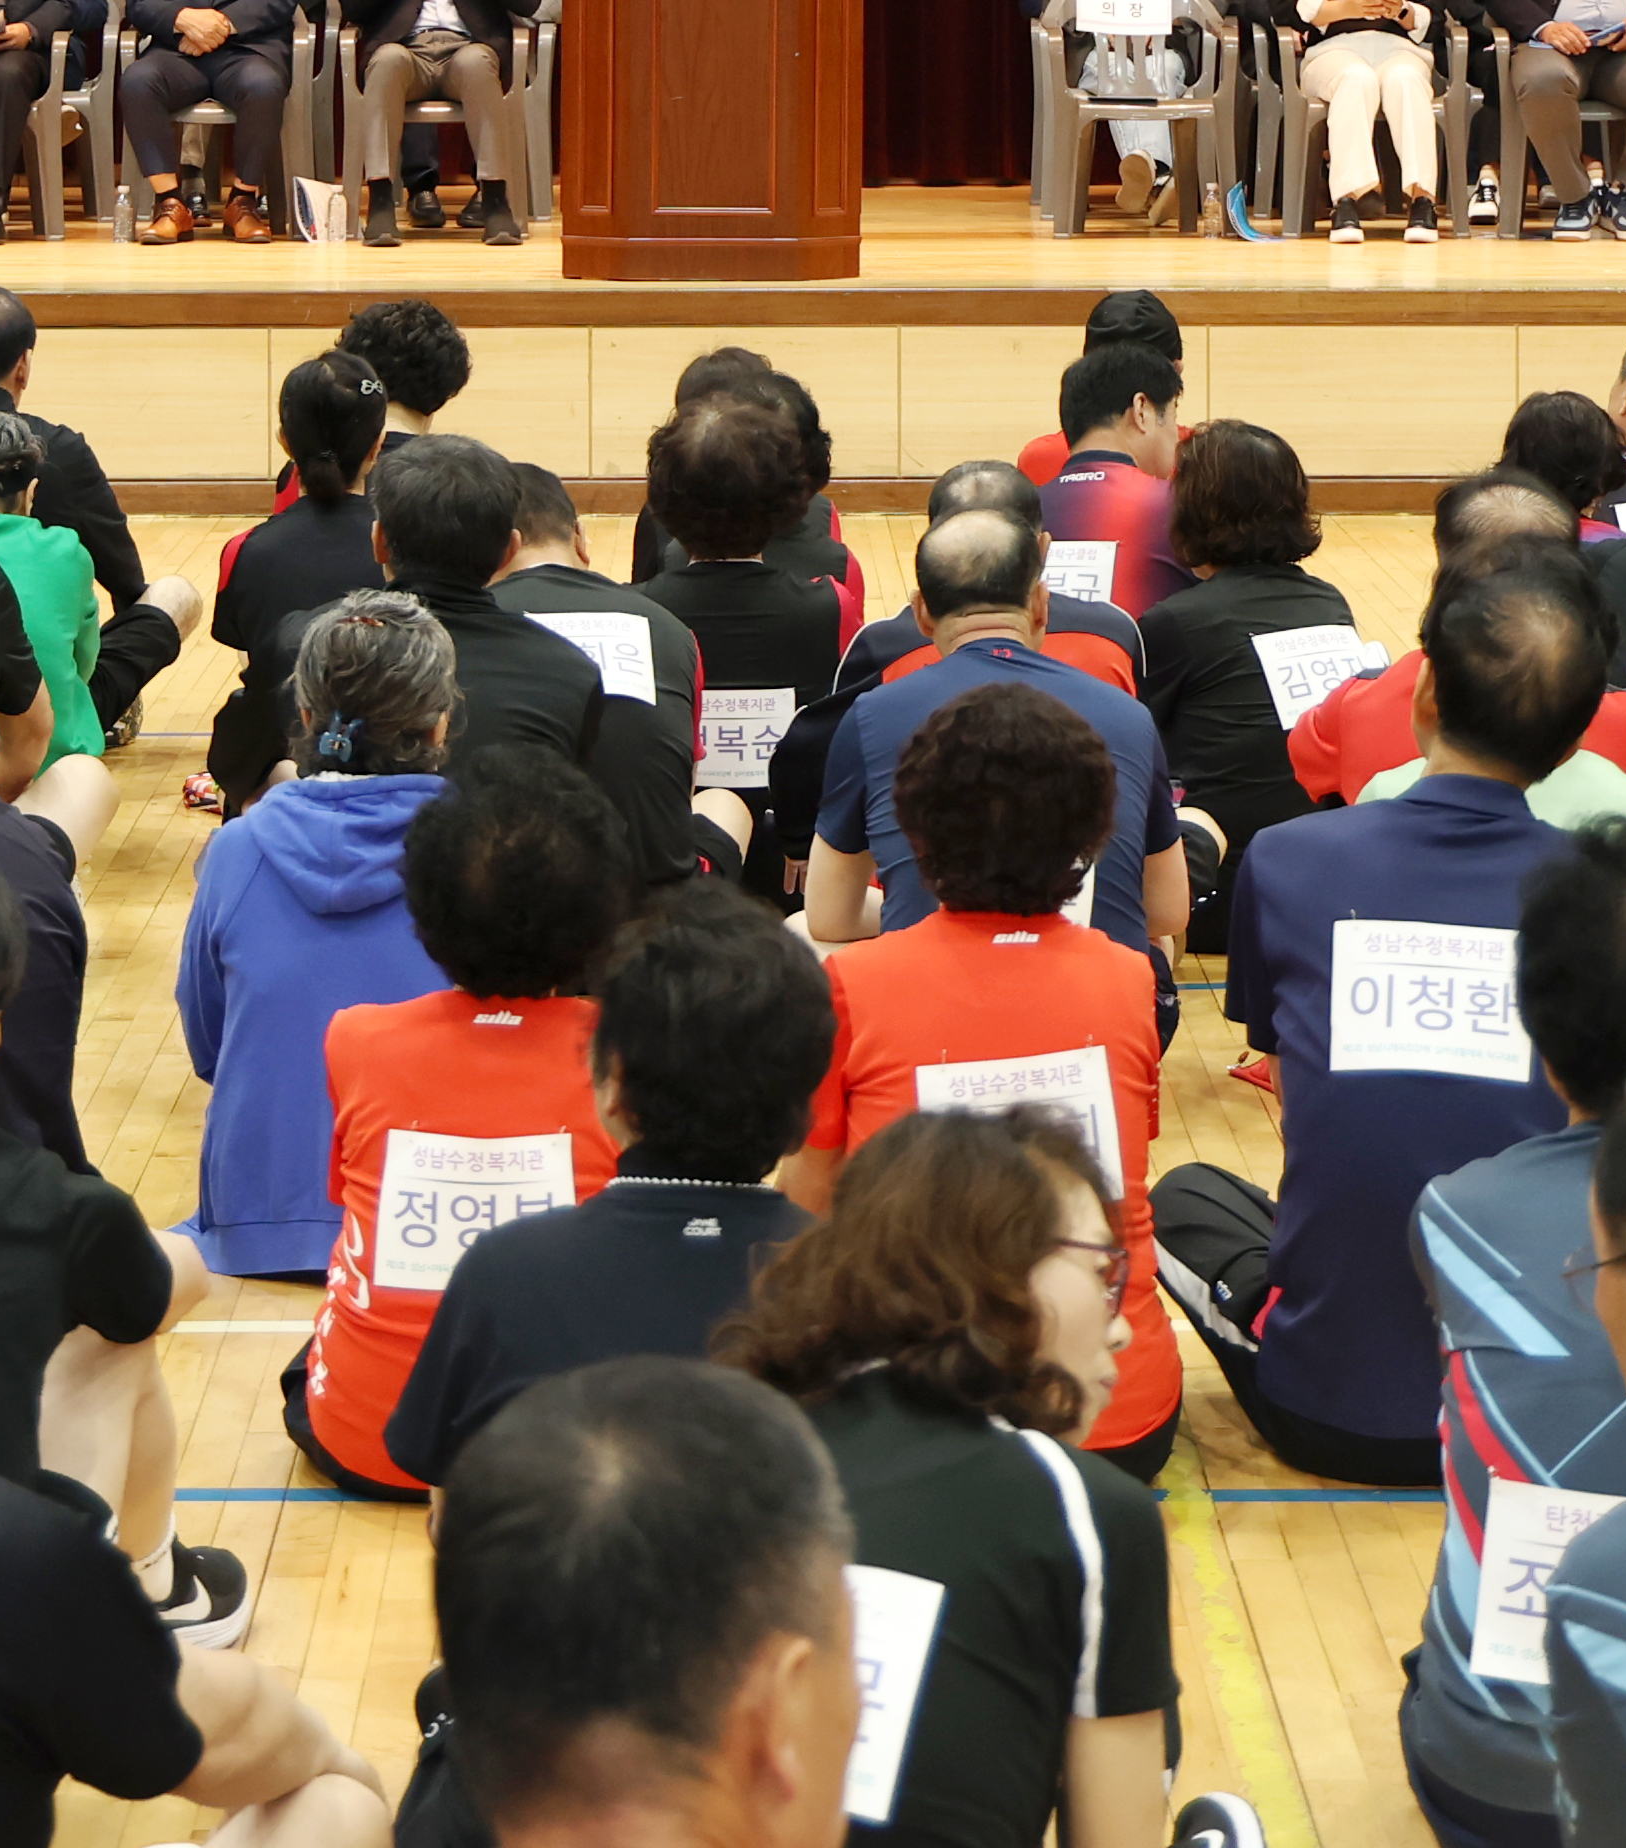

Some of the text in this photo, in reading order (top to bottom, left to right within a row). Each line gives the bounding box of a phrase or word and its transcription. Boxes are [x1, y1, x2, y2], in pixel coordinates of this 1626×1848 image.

[1059, 471, 1105, 484] TAGRO
[545, 618, 632, 632] 남수정복지관
[701, 697, 777, 712] 남수정복지관
[700, 725, 782, 762] 복순
[1364, 932, 1506, 961] 성남수정복지관
[1350, 973, 1518, 1037] 이청환
[949, 1063, 1083, 1099] 성남수정복지관
[413, 1145, 545, 1173] 성남수정복지관
